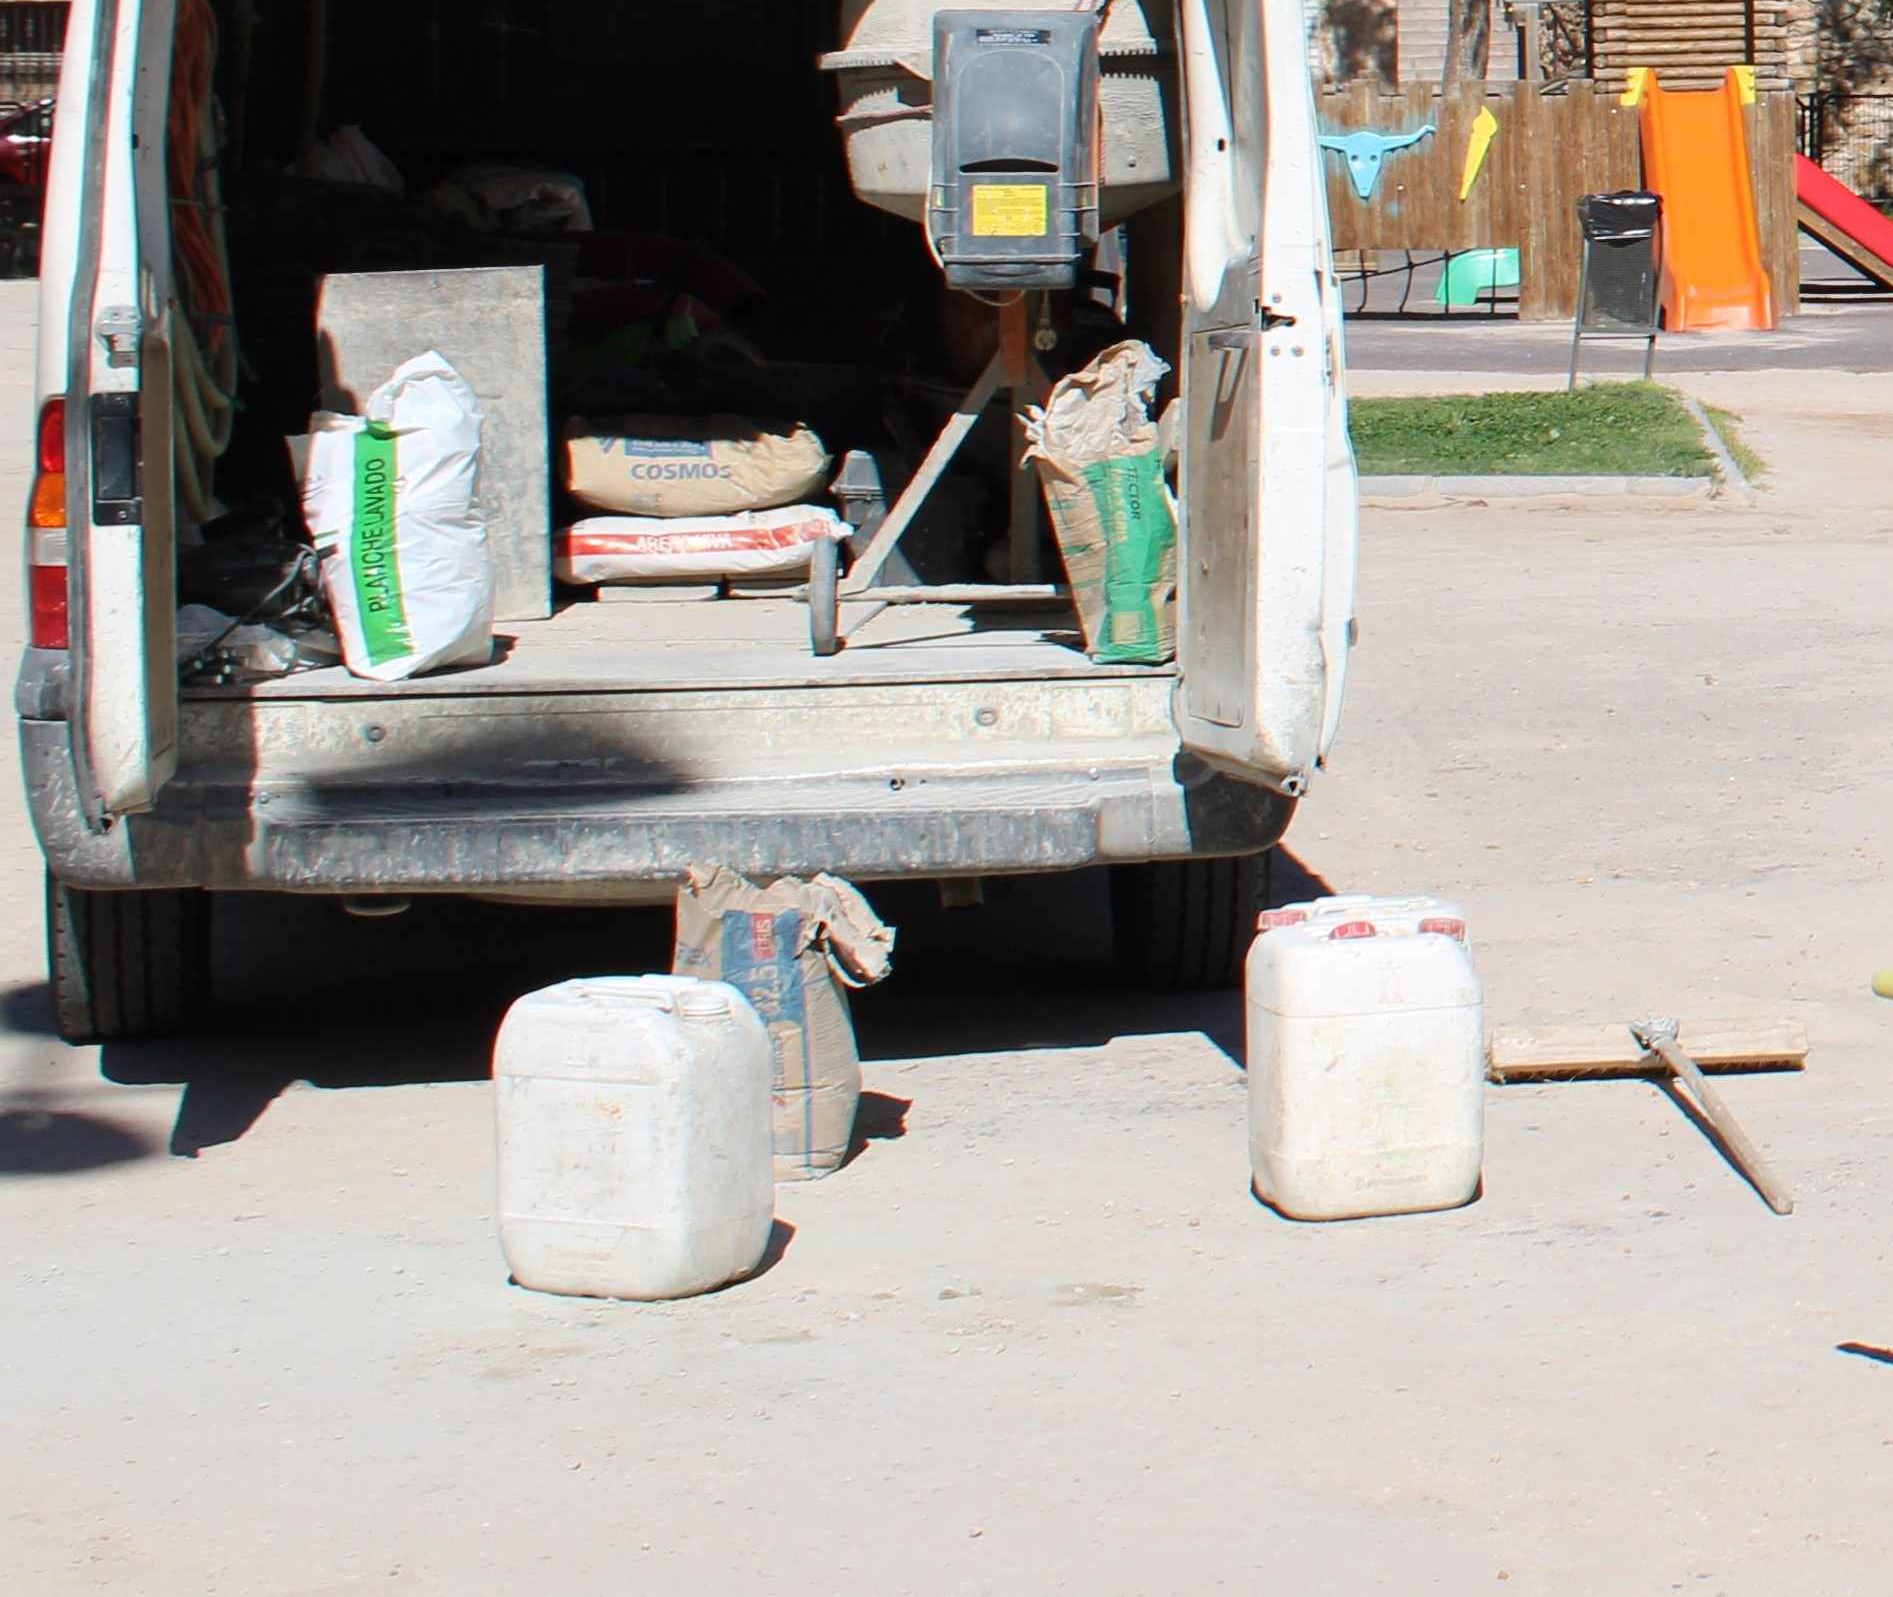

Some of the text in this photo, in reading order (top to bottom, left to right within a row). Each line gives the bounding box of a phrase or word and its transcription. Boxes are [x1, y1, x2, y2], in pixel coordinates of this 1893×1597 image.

[364, 458, 387, 526] LAVADO
[631, 463, 733, 481] COSMOS
[1127, 467, 1141, 520] TECTOR
[756, 919, 772, 950] GRIS
